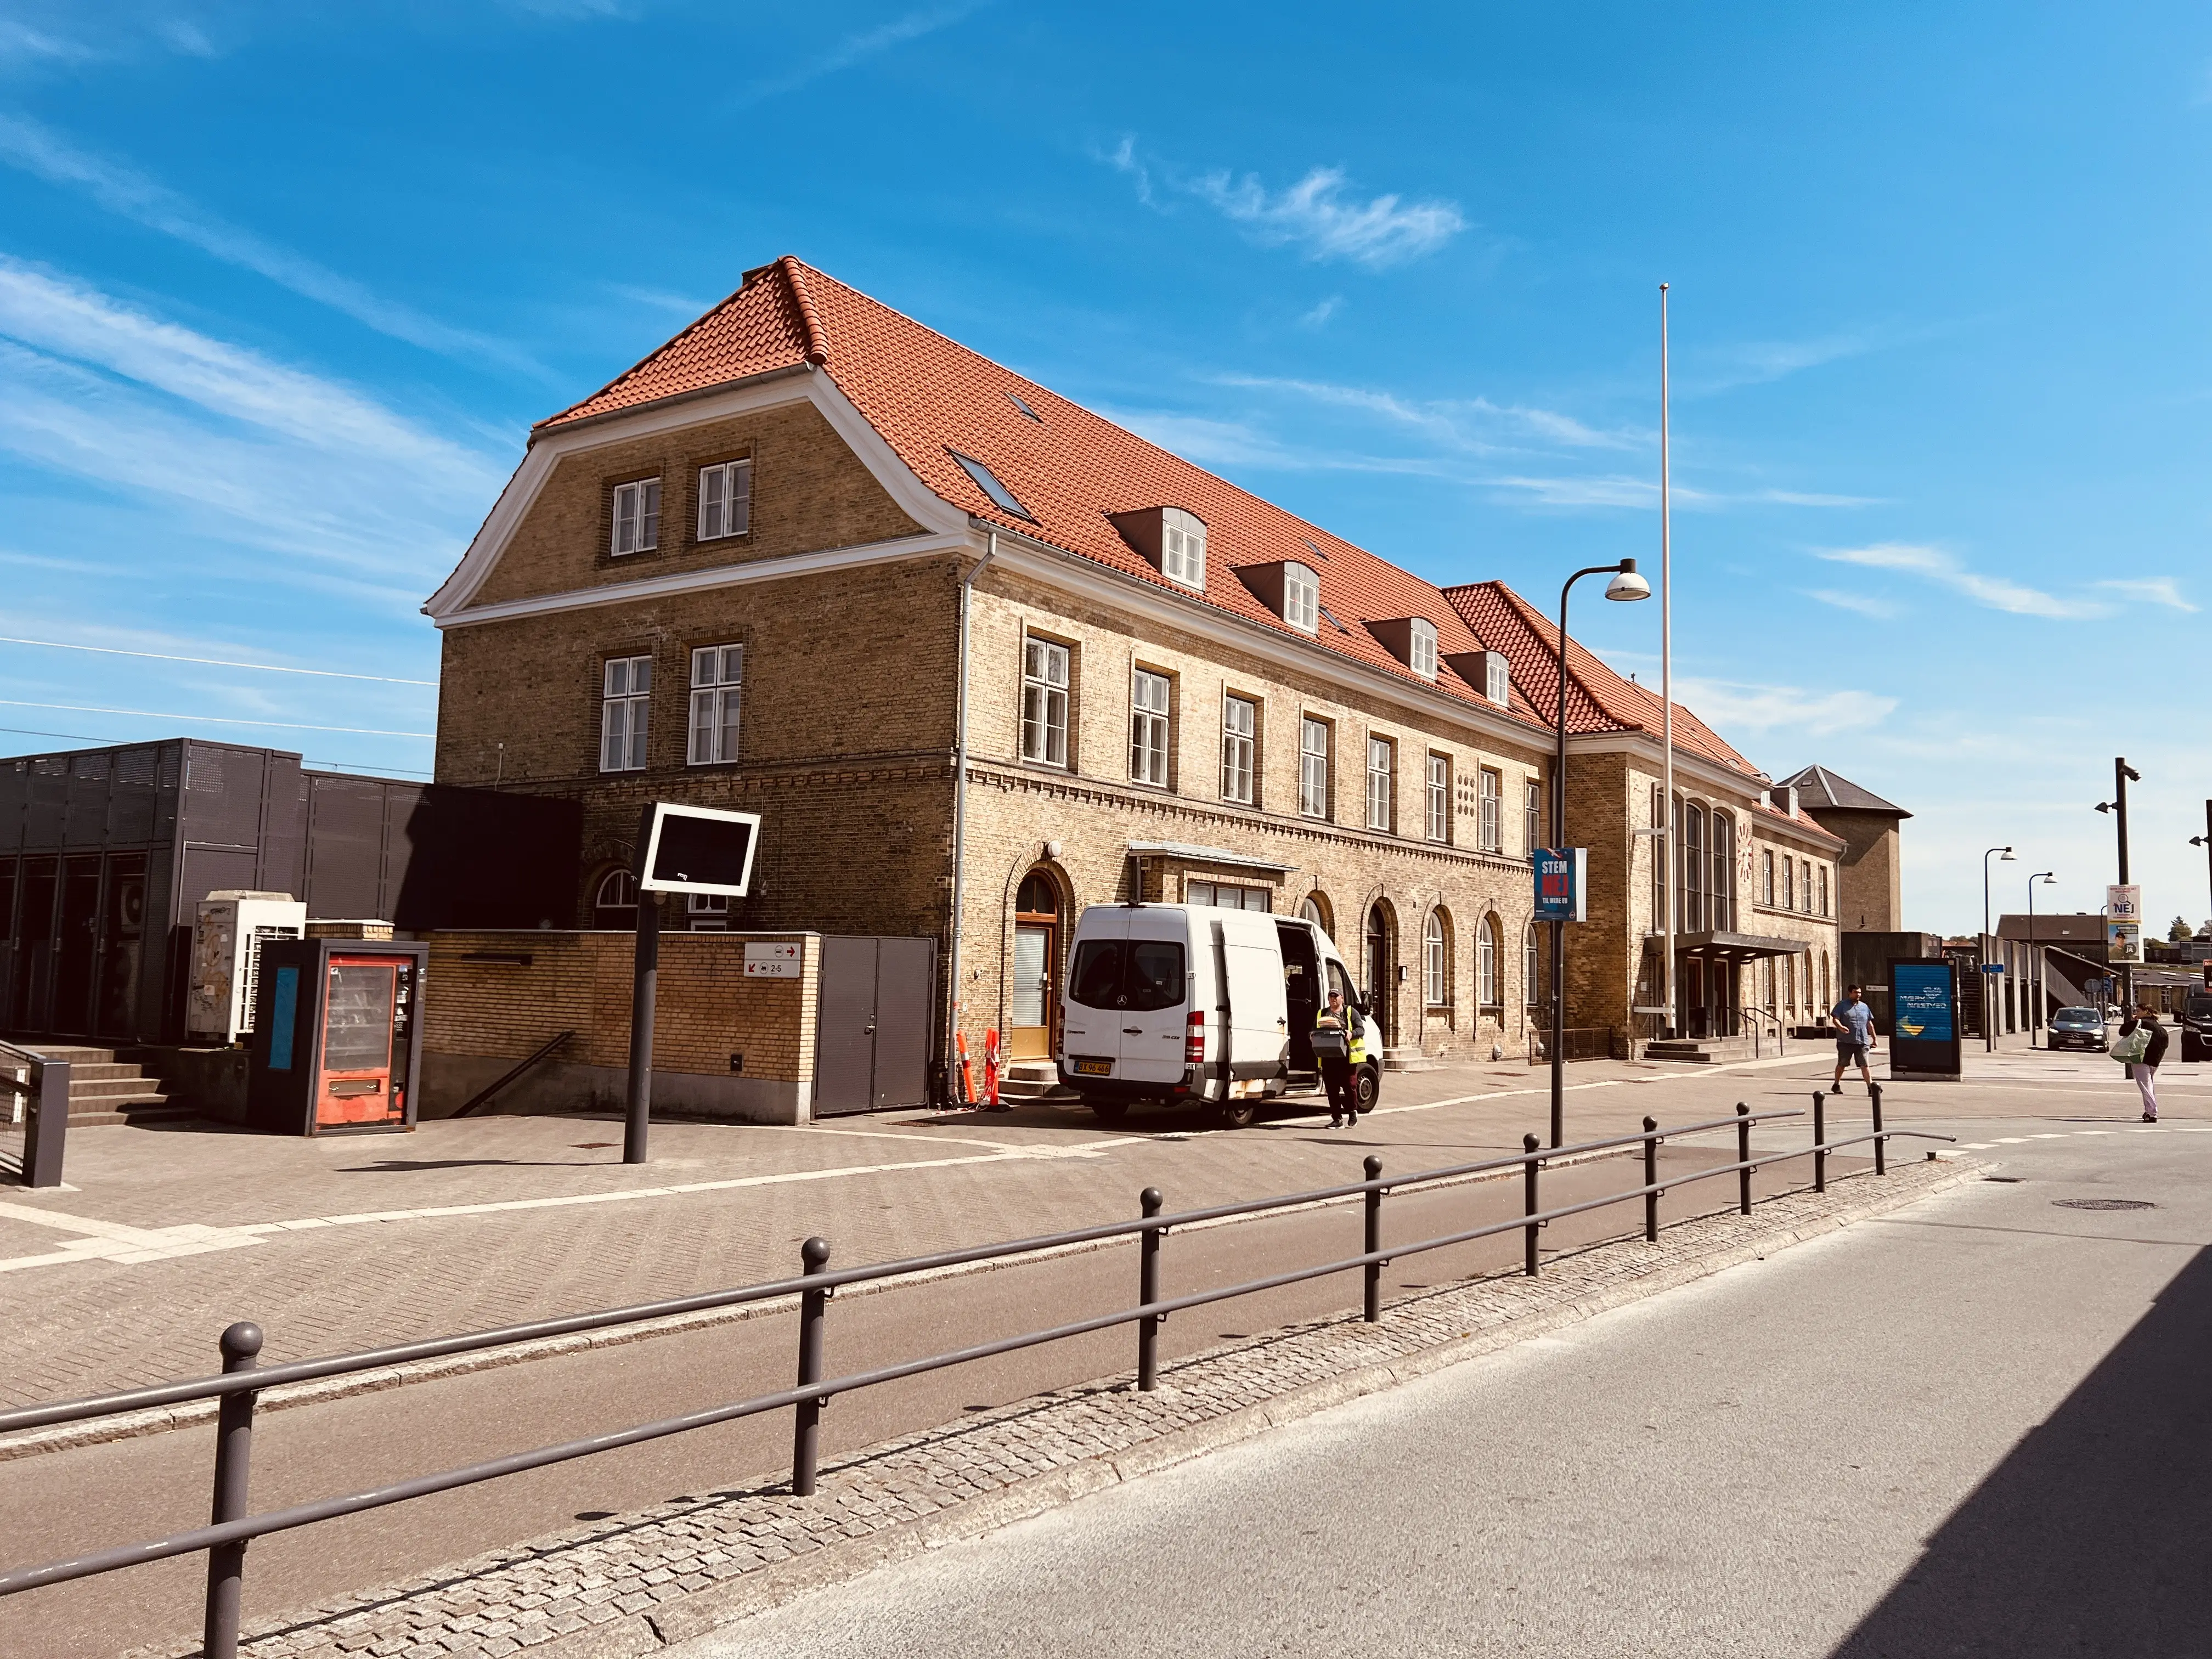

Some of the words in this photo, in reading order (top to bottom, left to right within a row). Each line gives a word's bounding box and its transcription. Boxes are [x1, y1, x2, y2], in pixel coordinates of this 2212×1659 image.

[1542, 861, 1567, 874] STEM
[1542, 874, 1568, 896] NEJ
[2114, 904, 2134, 913] NEJ
[1088, 1063, 1096, 1071] 96
[1097, 1064, 1109, 1073] 466
